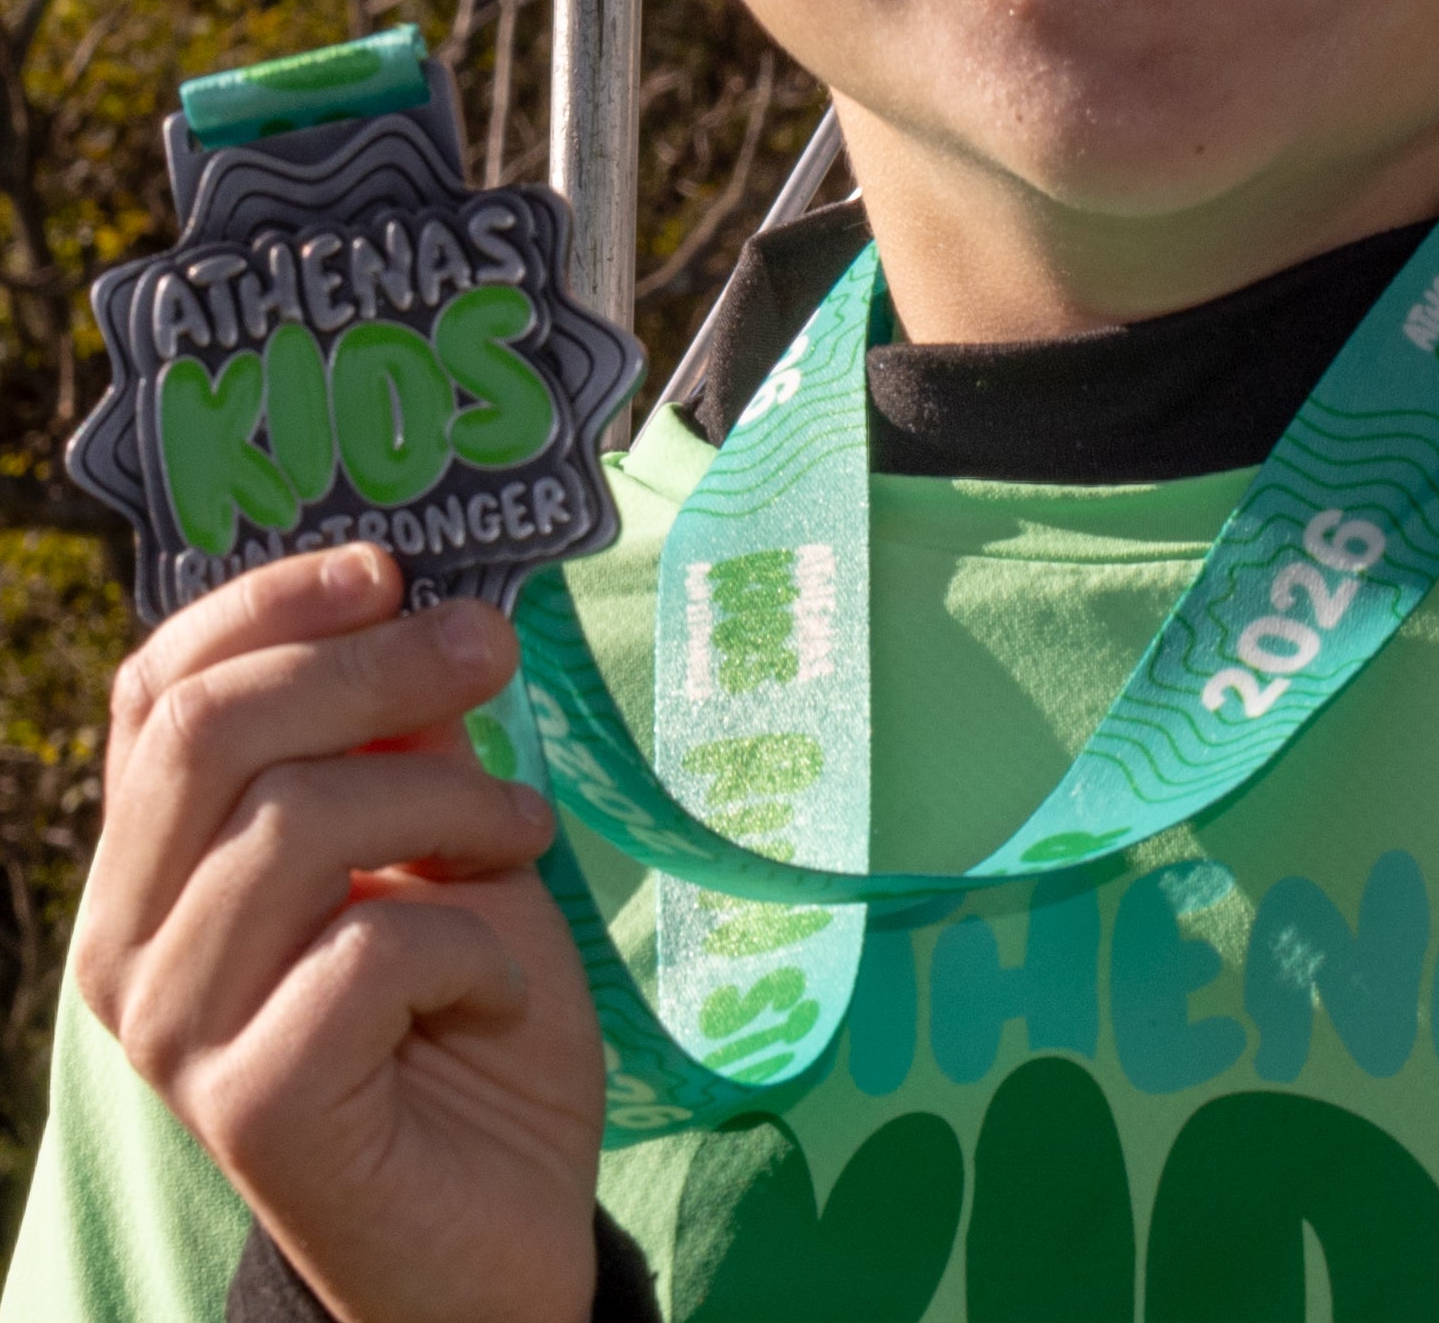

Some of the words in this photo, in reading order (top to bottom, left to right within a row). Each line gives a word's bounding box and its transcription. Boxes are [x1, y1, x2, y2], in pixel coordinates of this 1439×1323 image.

[153, 206, 524, 361] ATHENAS
[159, 285, 557, 556] KIDS
[1201, 508, 1387, 720] 2026
